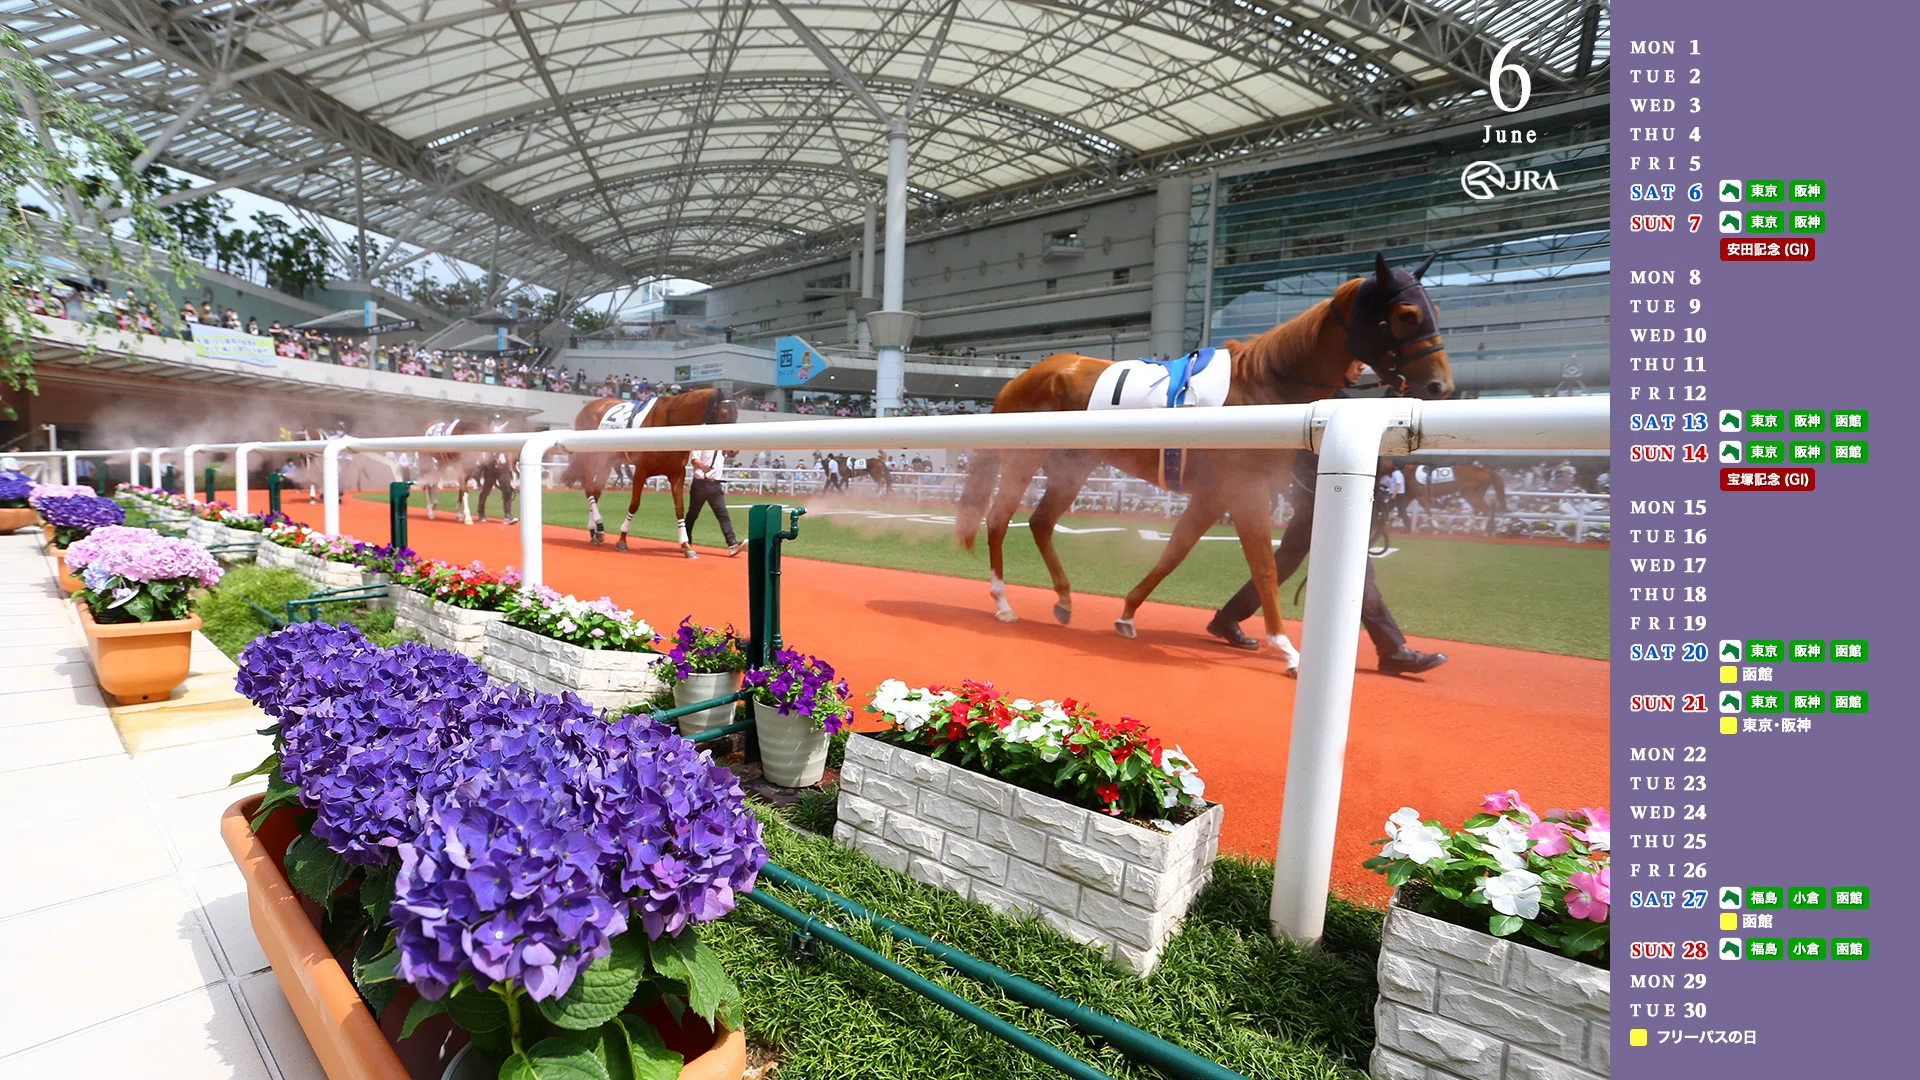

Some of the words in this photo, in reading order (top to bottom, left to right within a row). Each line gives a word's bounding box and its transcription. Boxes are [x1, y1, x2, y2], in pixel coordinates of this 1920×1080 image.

[780, 349, 793, 368] 西
[606, 404, 626, 422] 2
[1436, 468, 1450, 478] 10
